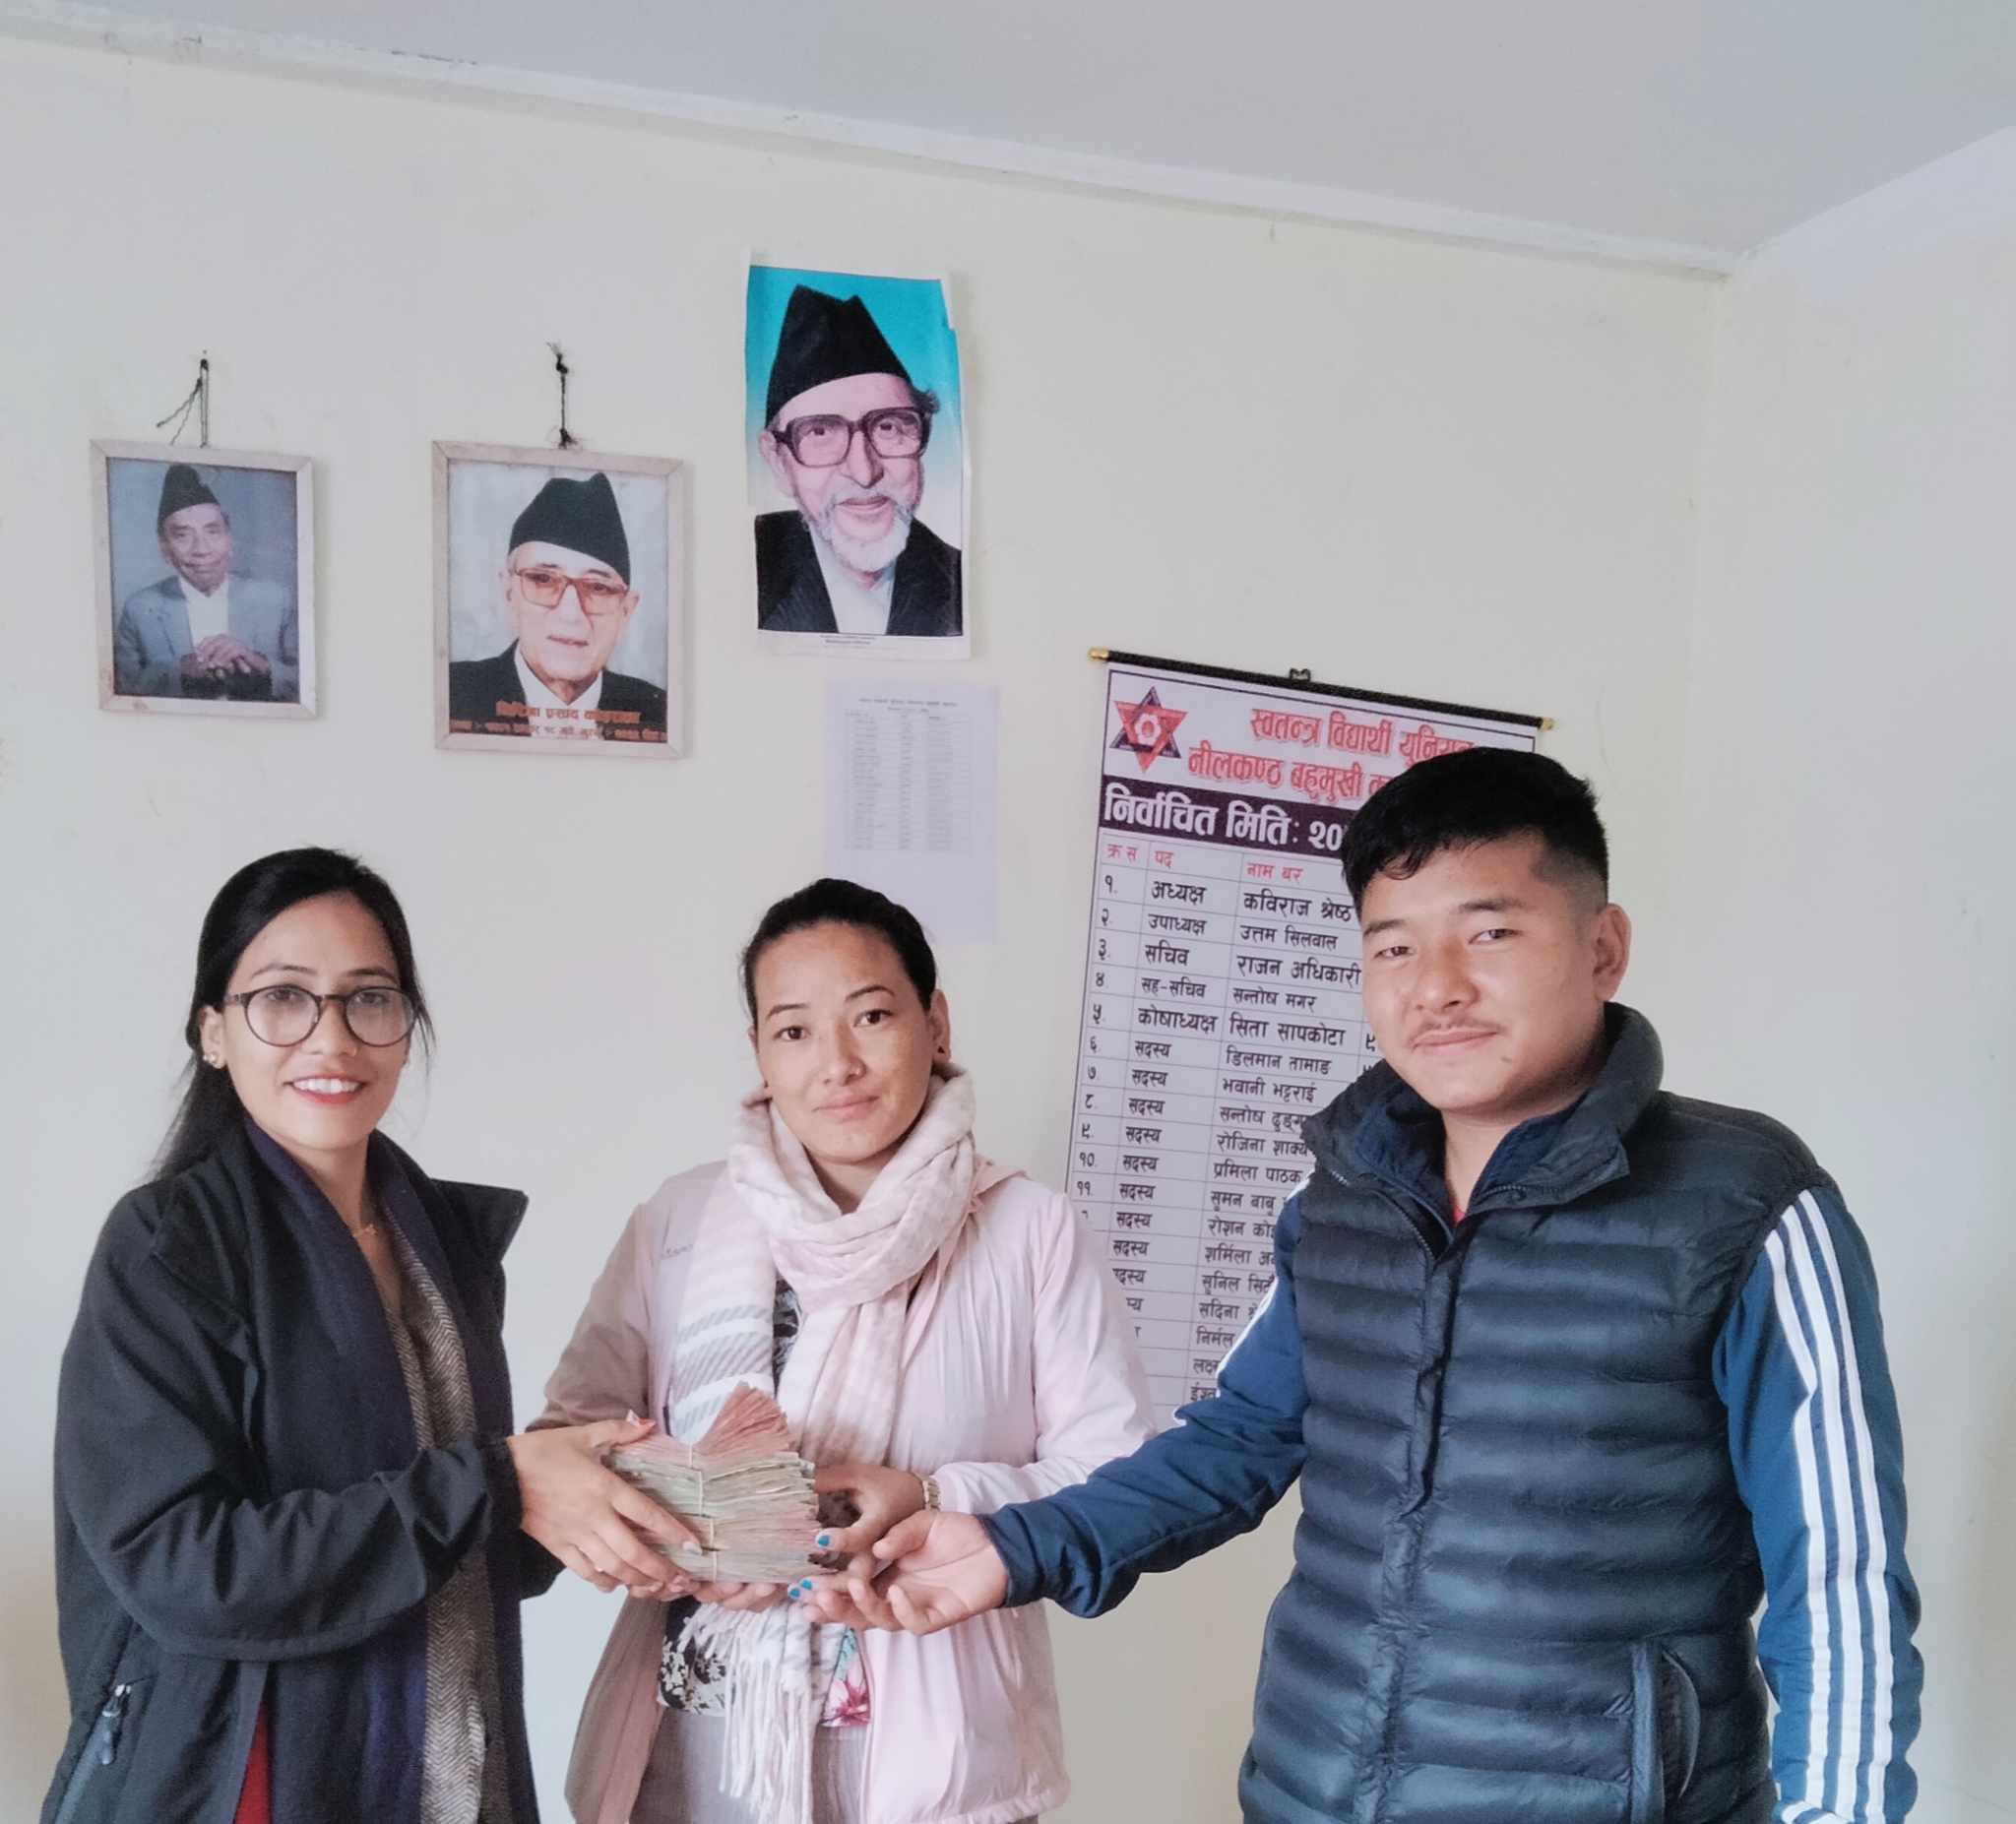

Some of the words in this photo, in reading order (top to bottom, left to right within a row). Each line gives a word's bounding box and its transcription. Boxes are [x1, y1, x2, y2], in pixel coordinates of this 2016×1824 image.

[1250, 708, 1322, 745] स्वतन्त्र
[1329, 710, 1393, 755] विद्यार्थी
[1187, 739, 1285, 788] नीलकण्ठ
[1291, 761, 1363, 803] बहुमुखी
[1103, 782, 1221, 836] निर्वाचित
[1308, 820, 1347, 852] २०
[1155, 850, 1173, 869] पद
[1247, 862, 1274, 878] नाम
[1152, 881, 1208, 906] अध्यक्ष
[1243, 888, 1312, 916] कविराज
[1148, 913, 1208, 935] उपाध्यक्ष
[1240, 925, 1277, 943] उत्तम
[1284, 924, 1338, 951] सिलवाल
[1145, 939, 1190, 966] सचिव
[1236, 955, 1283, 976] राजन
[1291, 956, 1361, 988] अधिकारी
[1141, 975, 1207, 998] सह-सचिव
[1232, 986, 1280, 1005] सन्तोष
[1286, 993, 1317, 1012] मगर
[1138, 1004, 1219, 1035] कोषाध्यक्ष
[1229, 1011, 1269, 1038] सिता
[1277, 1022, 1346, 1045] सापकोटा
[1134, 1040, 1172, 1059] सदस्य
[1227, 1044, 1283, 1069] डिलमान
[1132, 1069, 1168, 1087] सदस्य
[1223, 1077, 1266, 1097] भवानी
[1128, 1098, 1166, 1115] सदस्य
[1220, 1104, 1266, 1124] सन्तोष
[1126, 1126, 1163, 1144] सदस्य
[1217, 1130, 1266, 1152] रोजिना
[1123, 1155, 1160, 1172] सदस्य
[1214, 1158, 1258, 1181] प्रमिला
[1266, 1167, 1303, 1183] पाठक
[1119, 1183, 1156, 1201] सदस्य
[1211, 1190, 1244, 1212] सुमन
[1116, 1211, 1153, 1228] सदस्य
[1207, 1216, 1246, 1236] रोशन
[1112, 1240, 1150, 1257] सदस्य
[1205, 1242, 1252, 1264] शर्मिला
[1201, 1270, 1241, 1295] सुनिल
